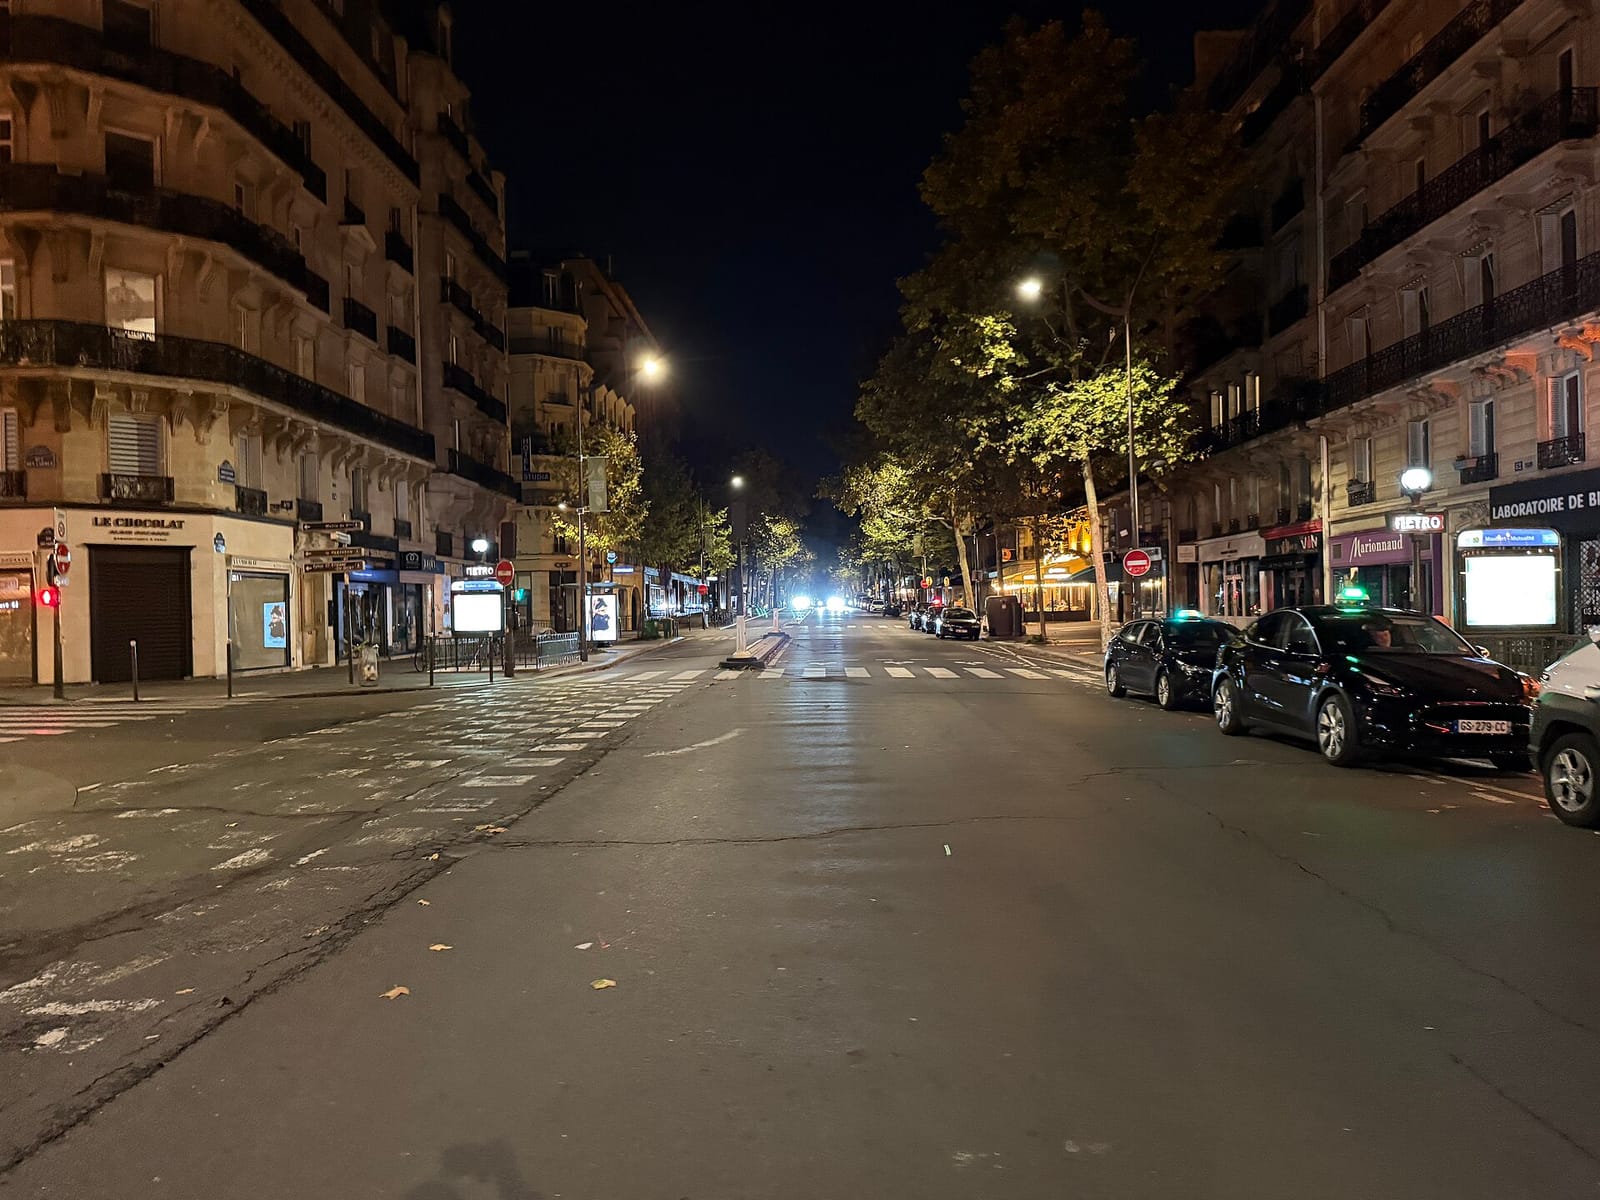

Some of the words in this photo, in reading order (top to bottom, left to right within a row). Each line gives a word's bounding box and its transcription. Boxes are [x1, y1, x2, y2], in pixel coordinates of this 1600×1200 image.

[1492, 497, 1564, 519] LABORATOIRE
[1568, 494, 1584, 509] DE
[92, 516, 111, 527] LE
[113, 517, 185, 530] CHOCOLAT
[1350, 534, 1403, 562] Marionnaud
